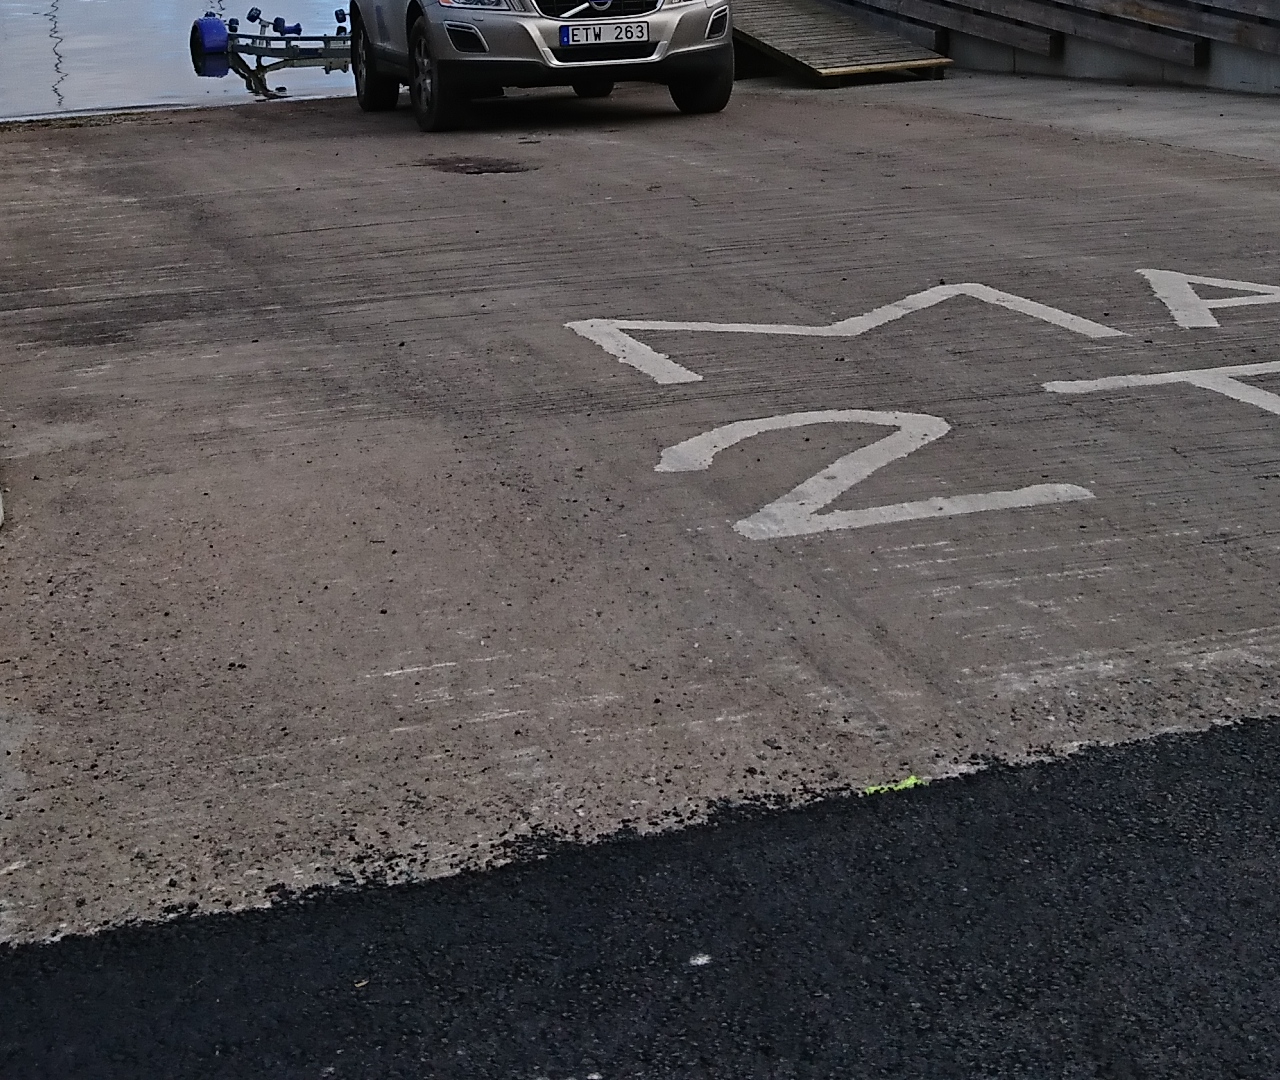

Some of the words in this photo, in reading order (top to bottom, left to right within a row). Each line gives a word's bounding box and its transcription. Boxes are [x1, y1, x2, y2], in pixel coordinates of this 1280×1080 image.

[571, 26, 602, 42] ETW
[614, 24, 645, 40] 263
[654, 409, 1097, 541] 2
